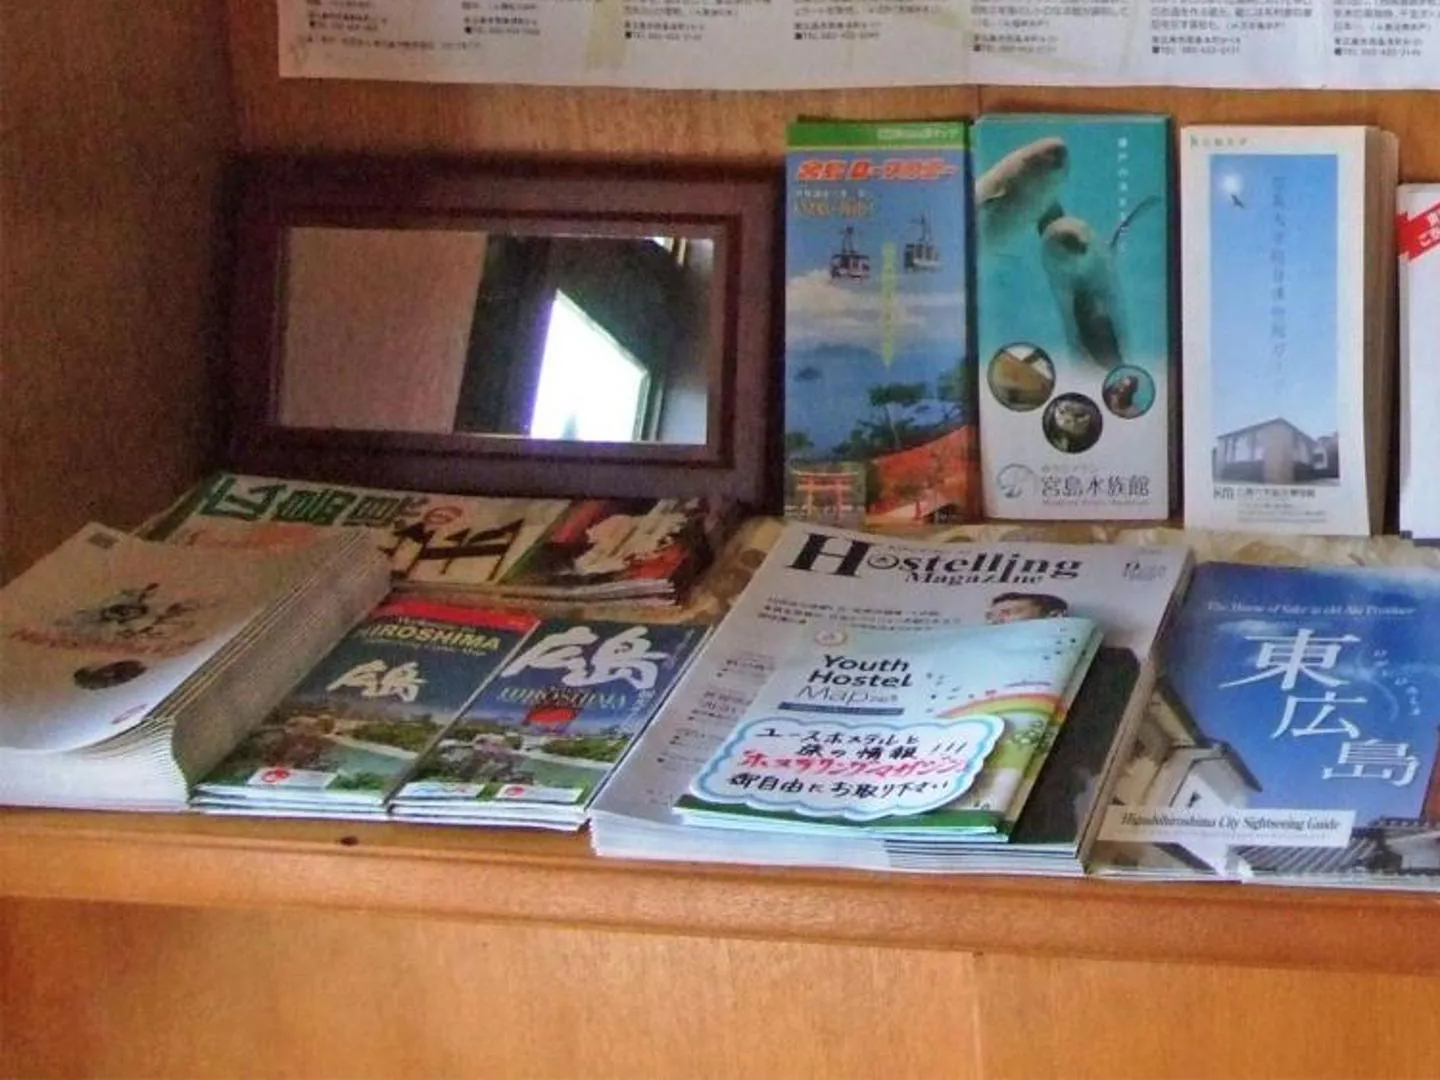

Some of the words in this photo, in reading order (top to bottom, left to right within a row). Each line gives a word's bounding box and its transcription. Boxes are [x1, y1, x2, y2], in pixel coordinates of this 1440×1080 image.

[1041, 474, 1150, 498] 宮島水族館
[786, 532, 1084, 580] Hostelling
[823, 654, 910, 672] Youth
[807, 669, 913, 687] Hostel
[1218, 627, 1419, 787] 東広島
[728, 772, 950, 799] 御自由にお取り下さい
